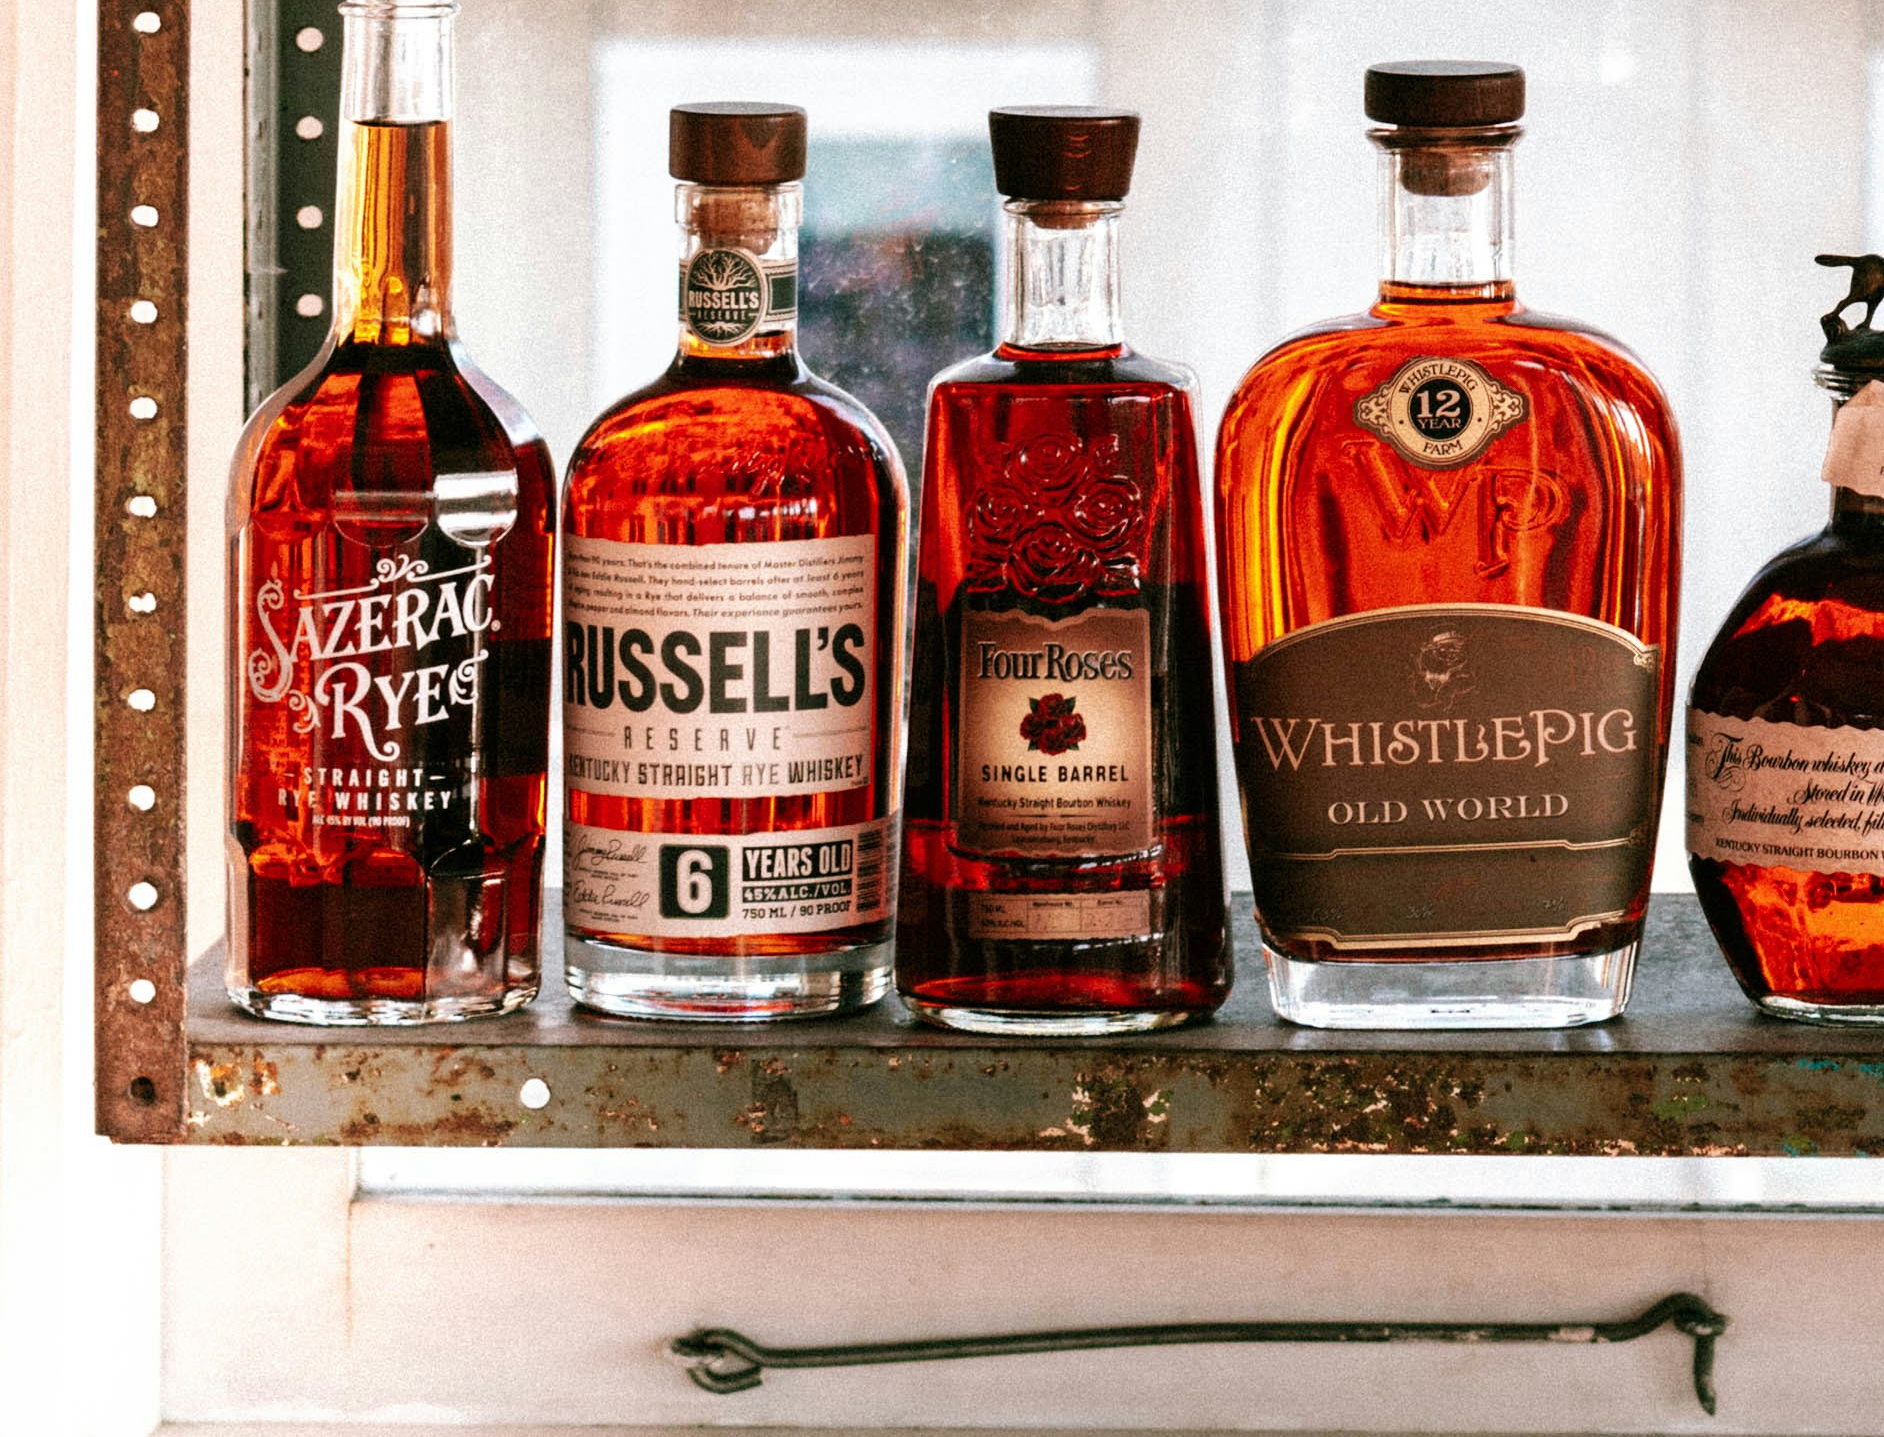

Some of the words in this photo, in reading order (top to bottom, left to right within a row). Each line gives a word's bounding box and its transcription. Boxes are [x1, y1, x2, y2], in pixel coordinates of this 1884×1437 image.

[688, 290, 760, 310] RUSSELL'S
[1399, 363, 1479, 395] WHISTLEPIG
[1416, 389, 1461, 418] 12
[1418, 418, 1462, 429] YEAR
[1423, 439, 1464, 456] FARM
[248, 574, 495, 703] SAZERAC
[566, 621, 865, 714] RUSSELL'S
[977, 642, 1042, 680] Four
[1043, 642, 1132, 682] Roses
[314, 662, 450, 762] RYE
[624, 727, 782, 751] RESERVE
[1251, 708, 1637, 772] WHISTLEPIG
[303, 768, 424, 788] STRAIGHT
[567, 754, 631, 785] KENTUCKY
[637, 764, 732, 788] STRAIGHT
[741, 762, 780, 786] RYE
[788, 754, 863, 785] WHISKEY
[981, 765, 1048, 782] SINGLE
[1058, 765, 1129, 782] BARREL
[1328, 800, 1407, 825] OLD
[1422, 794, 1569, 821] WORLD
[745, 849, 813, 879] YEARS
[819, 847, 852, 873] OLD
[1715, 838, 1761, 853] KENTUCKY
[1762, 844, 1814, 858] STRAIGHT
[1817, 846, 1878, 861] BOURBON
[675, 848, 715, 916] 6
